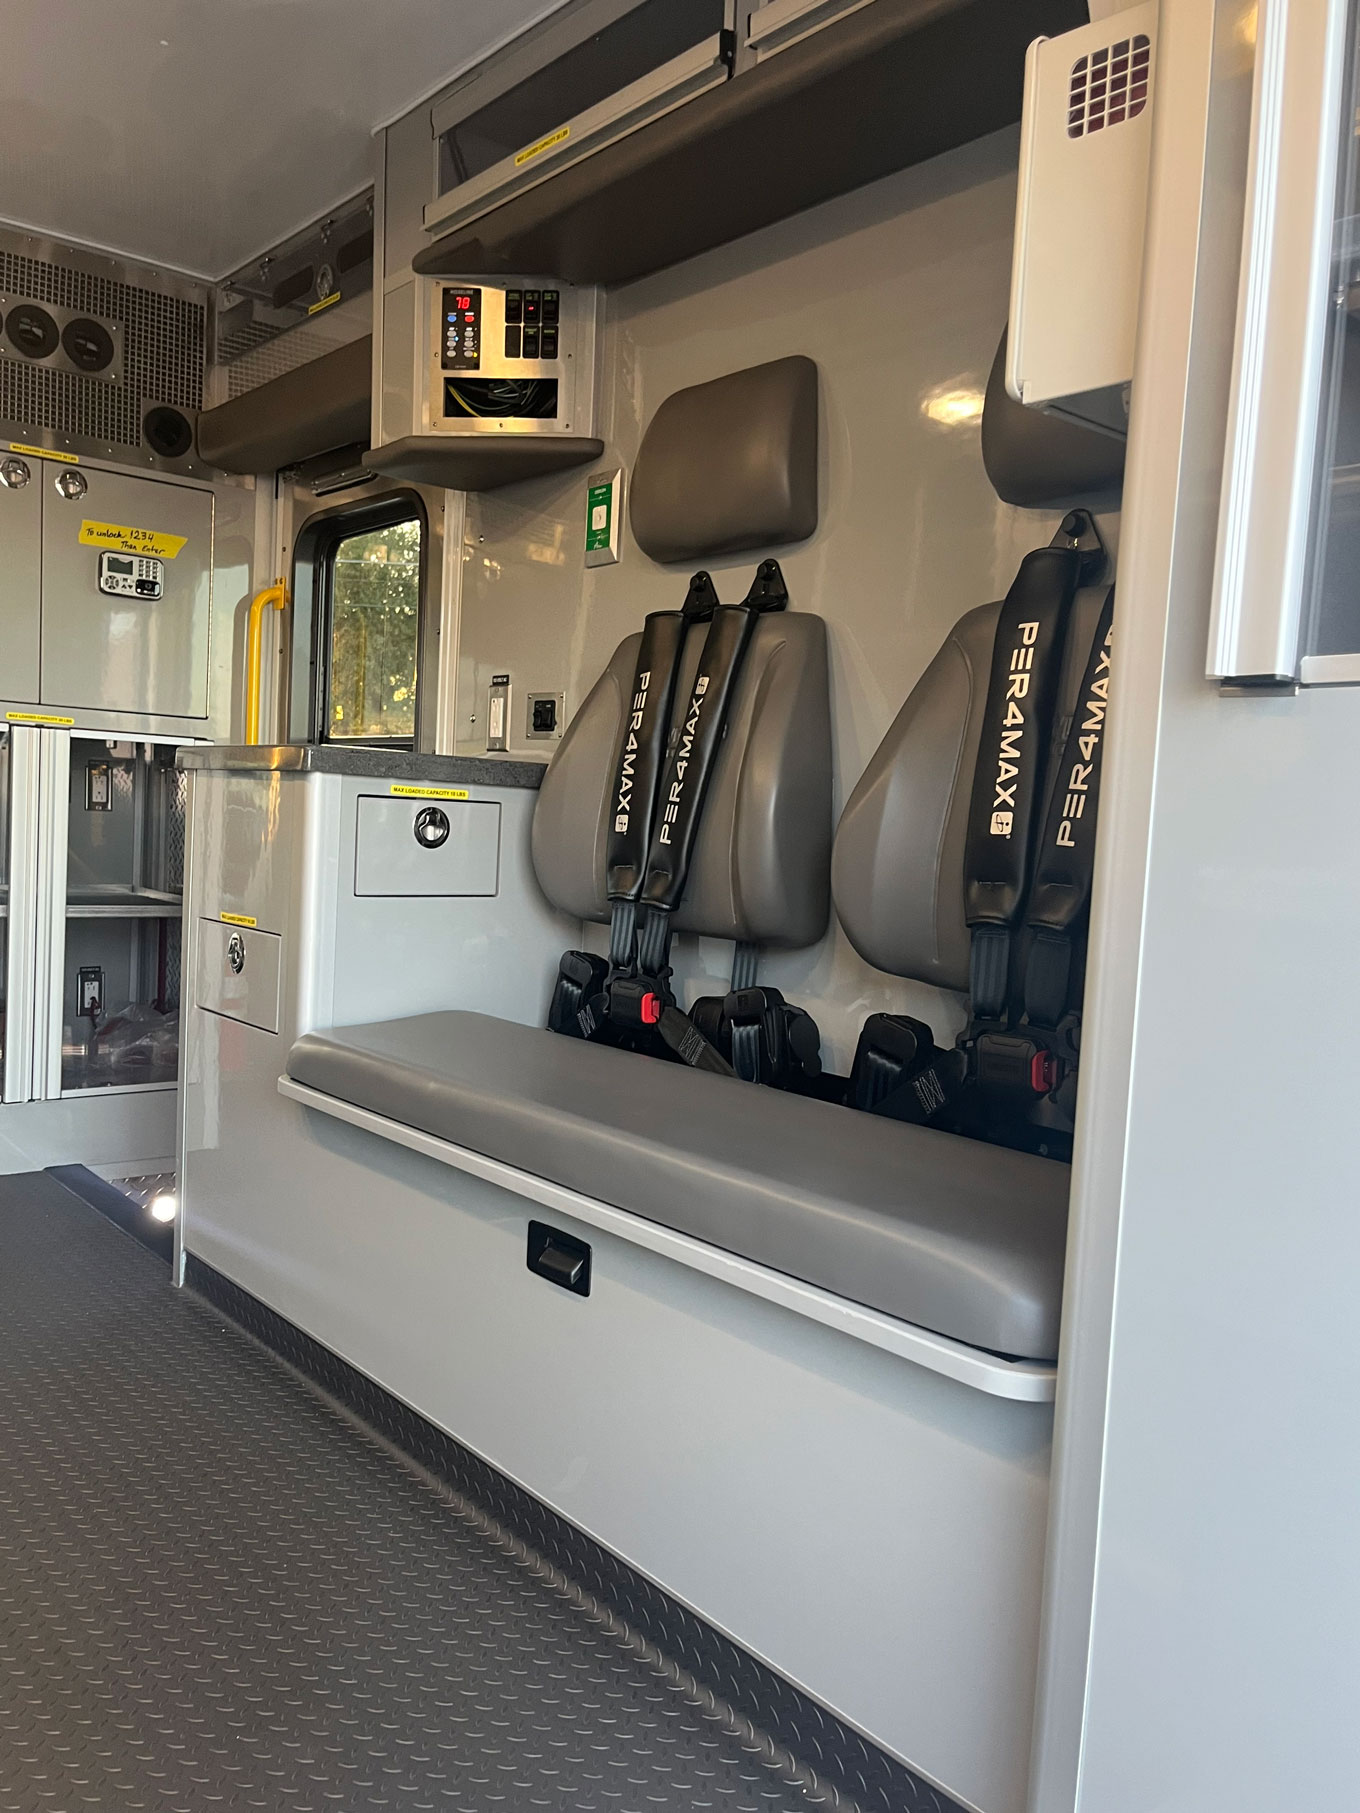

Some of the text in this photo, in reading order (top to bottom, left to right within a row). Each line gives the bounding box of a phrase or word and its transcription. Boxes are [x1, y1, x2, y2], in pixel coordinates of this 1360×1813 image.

[455, 296, 471, 310] 78
[86, 527, 155, 542] To unlock 1234
[141, 545, 166, 555] Enter
[616, 670, 652, 812] PER4MAX
[659, 697, 704, 846] PER4MAX
[992, 620, 1041, 808] PER4MAX
[1055, 650, 1112, 848] PER4MAX
